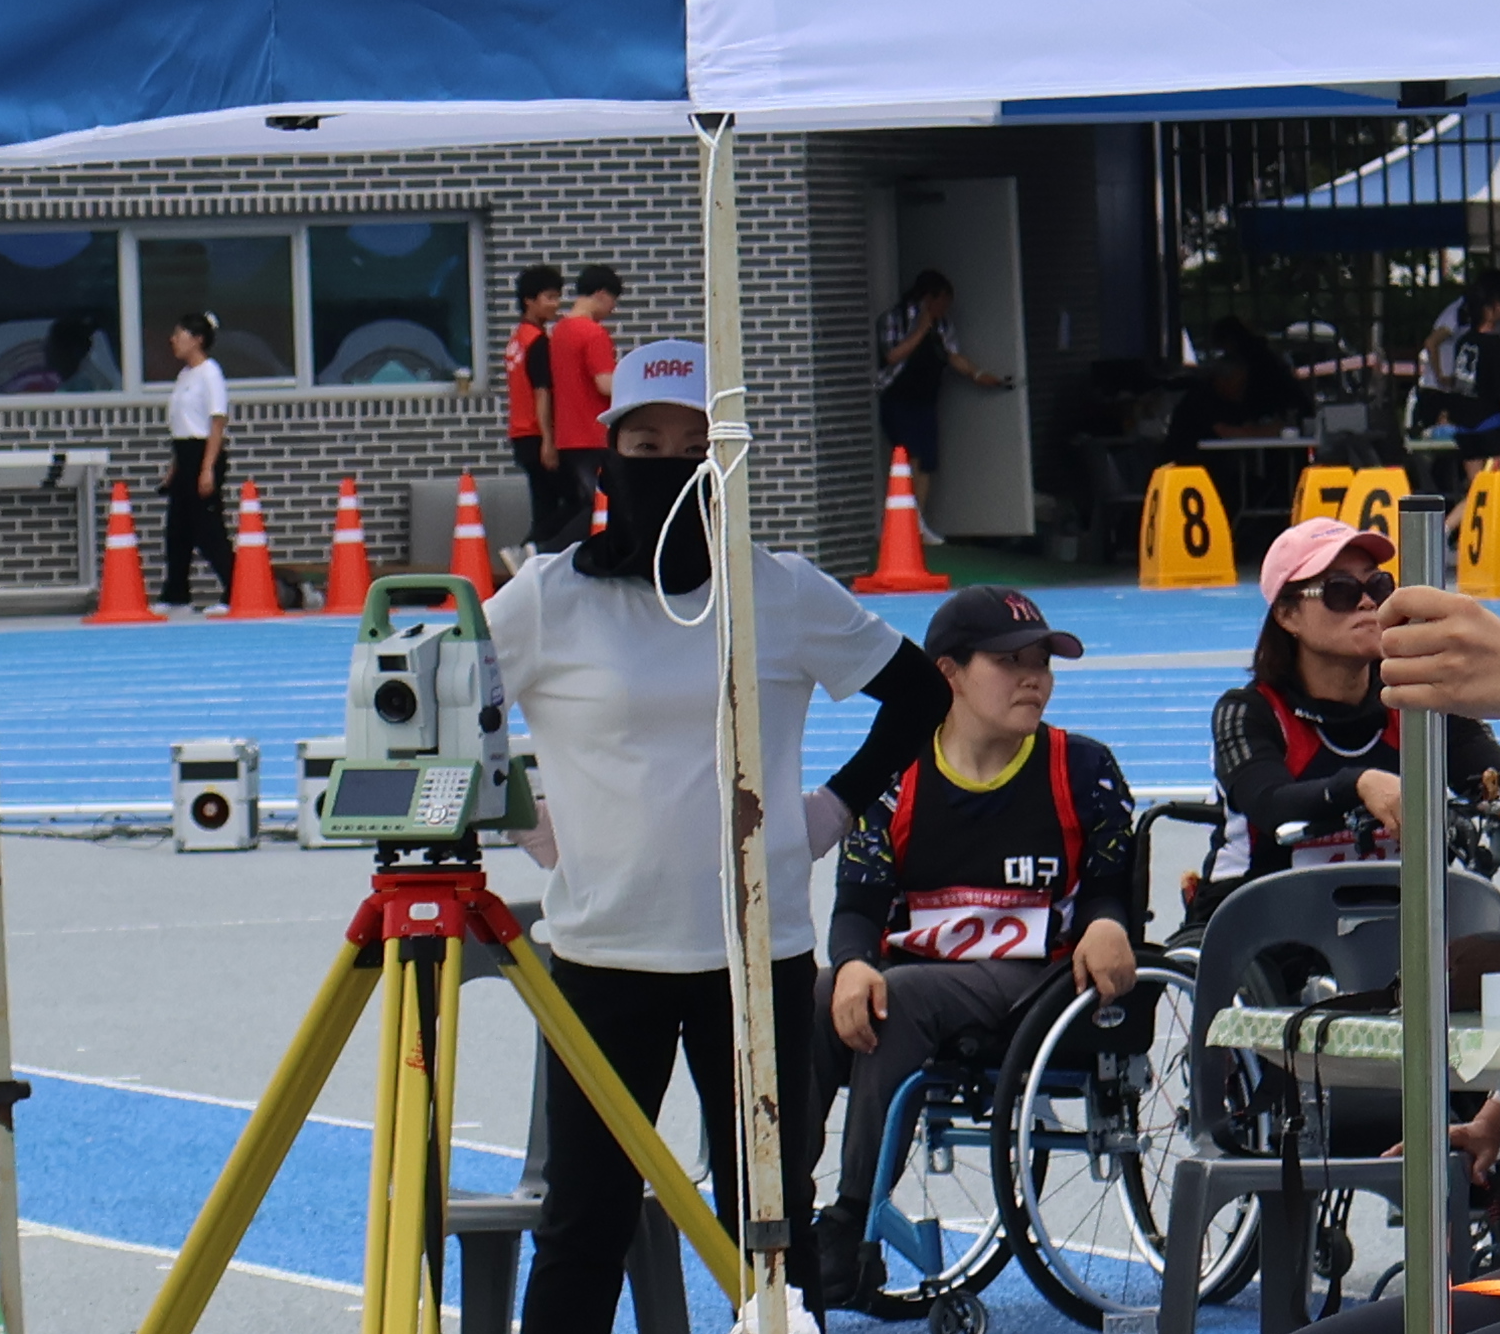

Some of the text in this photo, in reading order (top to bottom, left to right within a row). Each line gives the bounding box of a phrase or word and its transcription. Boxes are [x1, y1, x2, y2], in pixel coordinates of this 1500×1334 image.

[643, 359, 694, 380] KAAF
[1180, 486, 1210, 558] 8
[1468, 491, 1488, 566] 5
[1004, 855, 1060, 886] 대구
